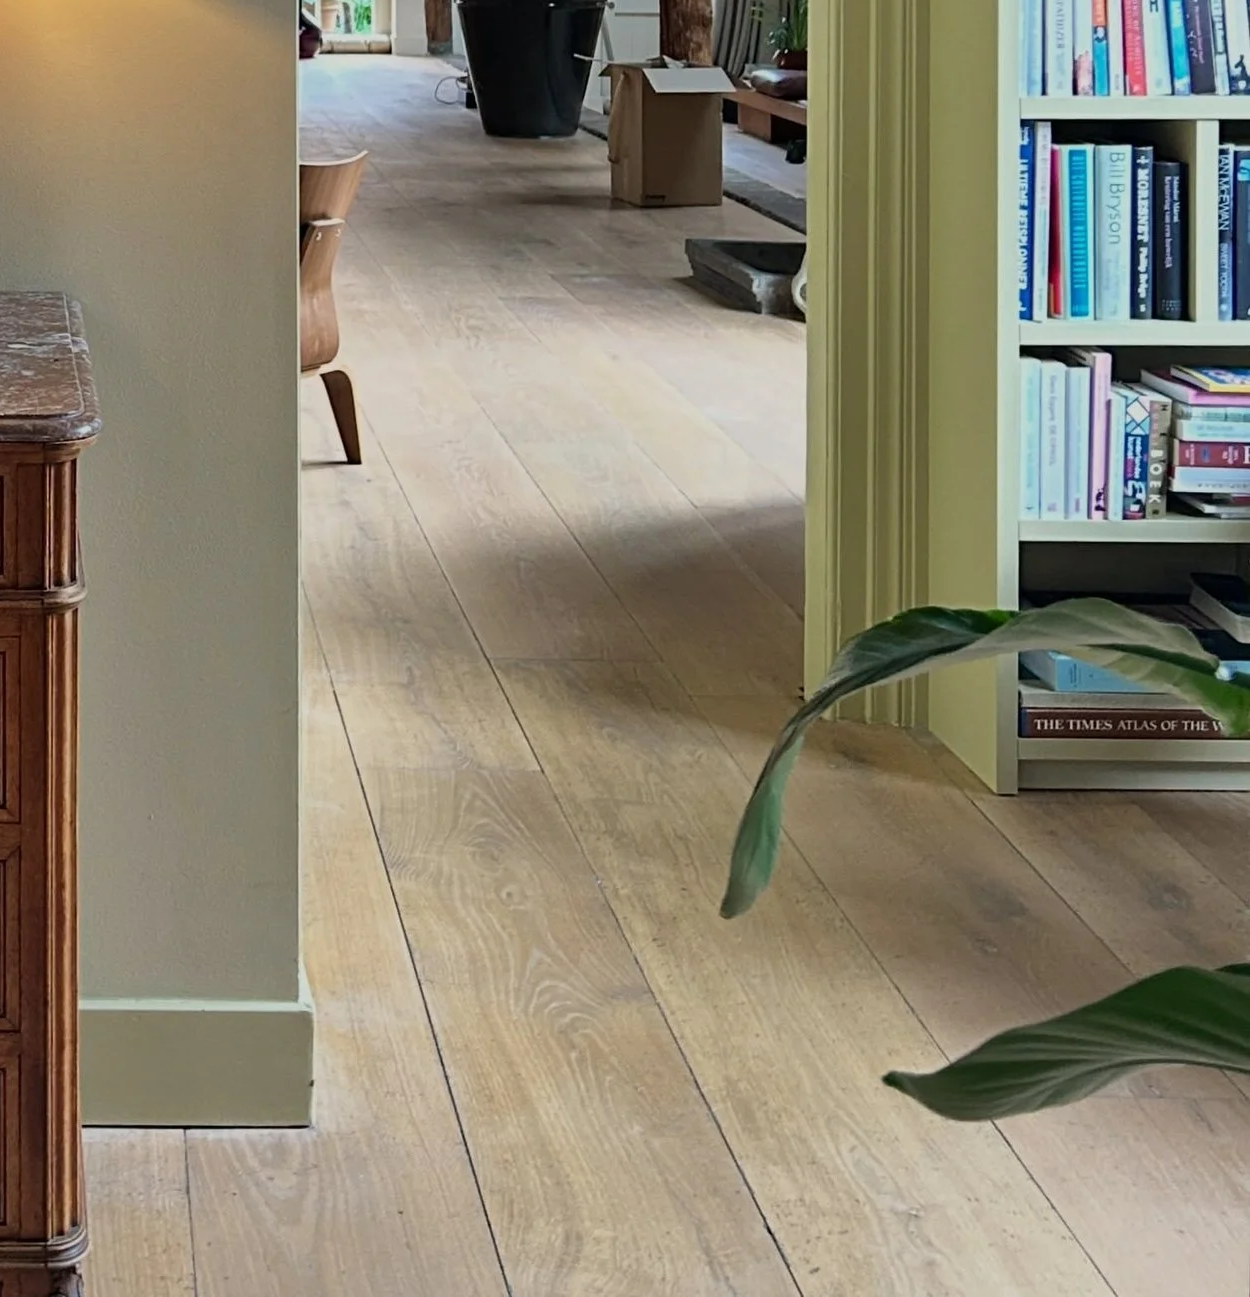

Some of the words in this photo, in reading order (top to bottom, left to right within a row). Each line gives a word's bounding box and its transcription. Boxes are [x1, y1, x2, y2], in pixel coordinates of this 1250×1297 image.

[1109, 152, 1125, 178] Bill
[1218, 154, 1230, 174] IAN
[1107, 184, 1125, 245] Bryson
[1137, 168, 1149, 242] MORESNET
[1218, 177, 1230, 230] McEWAN
[1150, 450, 1163, 504] BOEK
[1034, 719, 1064, 730] THE
[1066, 718, 1113, 730] TIMES
[1117, 719, 1157, 730] ATLAS
[1160, 719, 1178, 731] OF
[1181, 720, 1209, 731] THE
